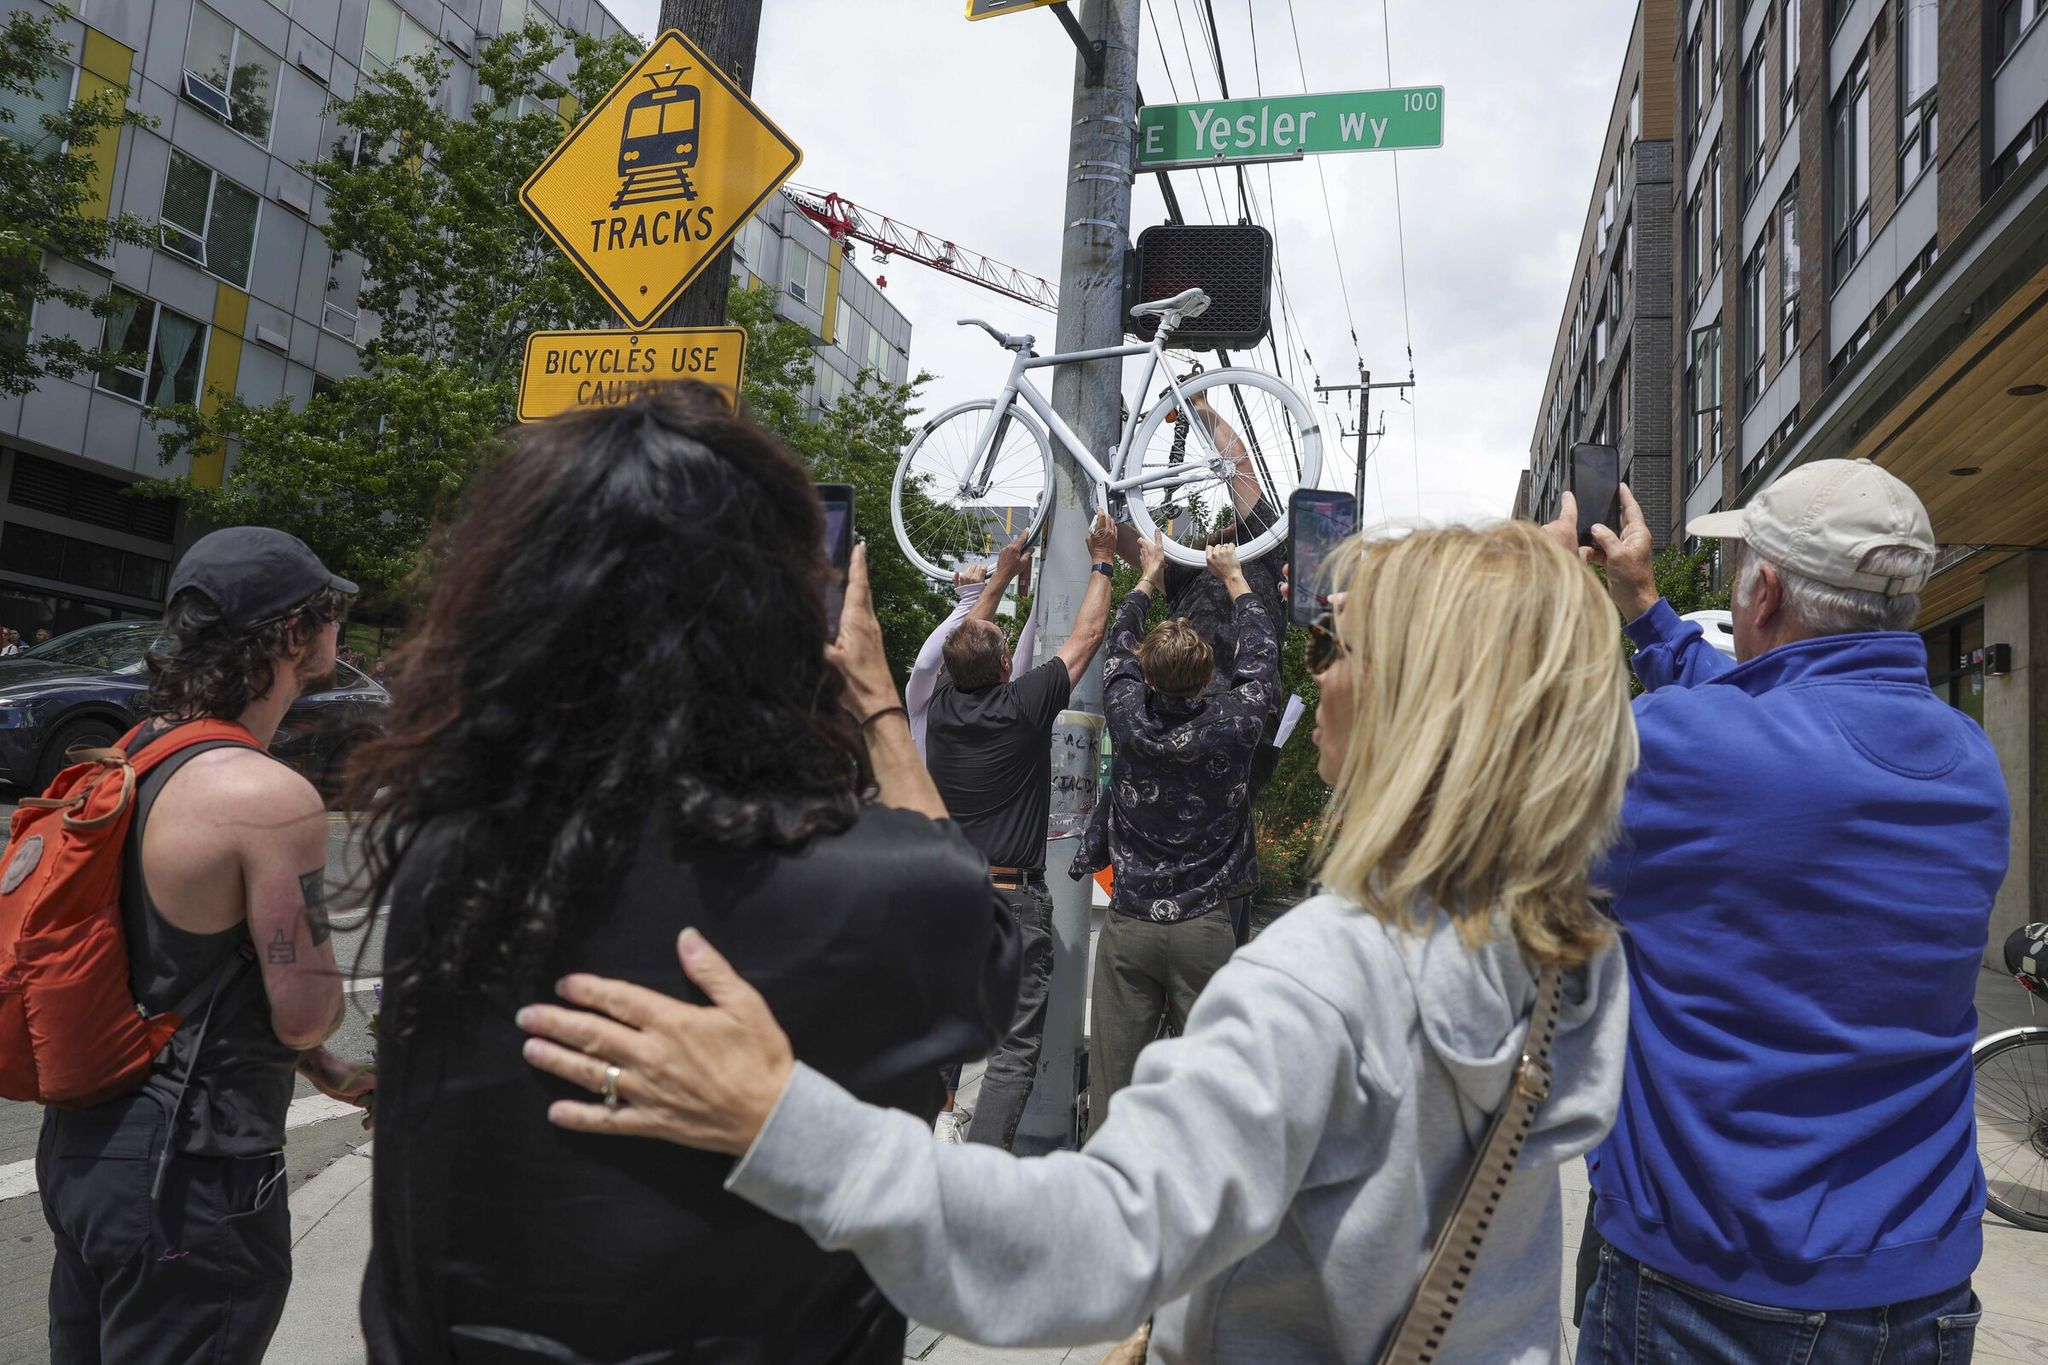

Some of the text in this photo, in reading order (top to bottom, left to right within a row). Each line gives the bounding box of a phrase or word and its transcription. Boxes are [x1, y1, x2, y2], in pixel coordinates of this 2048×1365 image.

[1403, 92, 1438, 112] 100
[1145, 104, 1389, 154] E Yesler Wy
[590, 206, 715, 252] TRACKS
[545, 346, 719, 375] BICYCLES USE
[577, 378, 676, 406] CAUT
